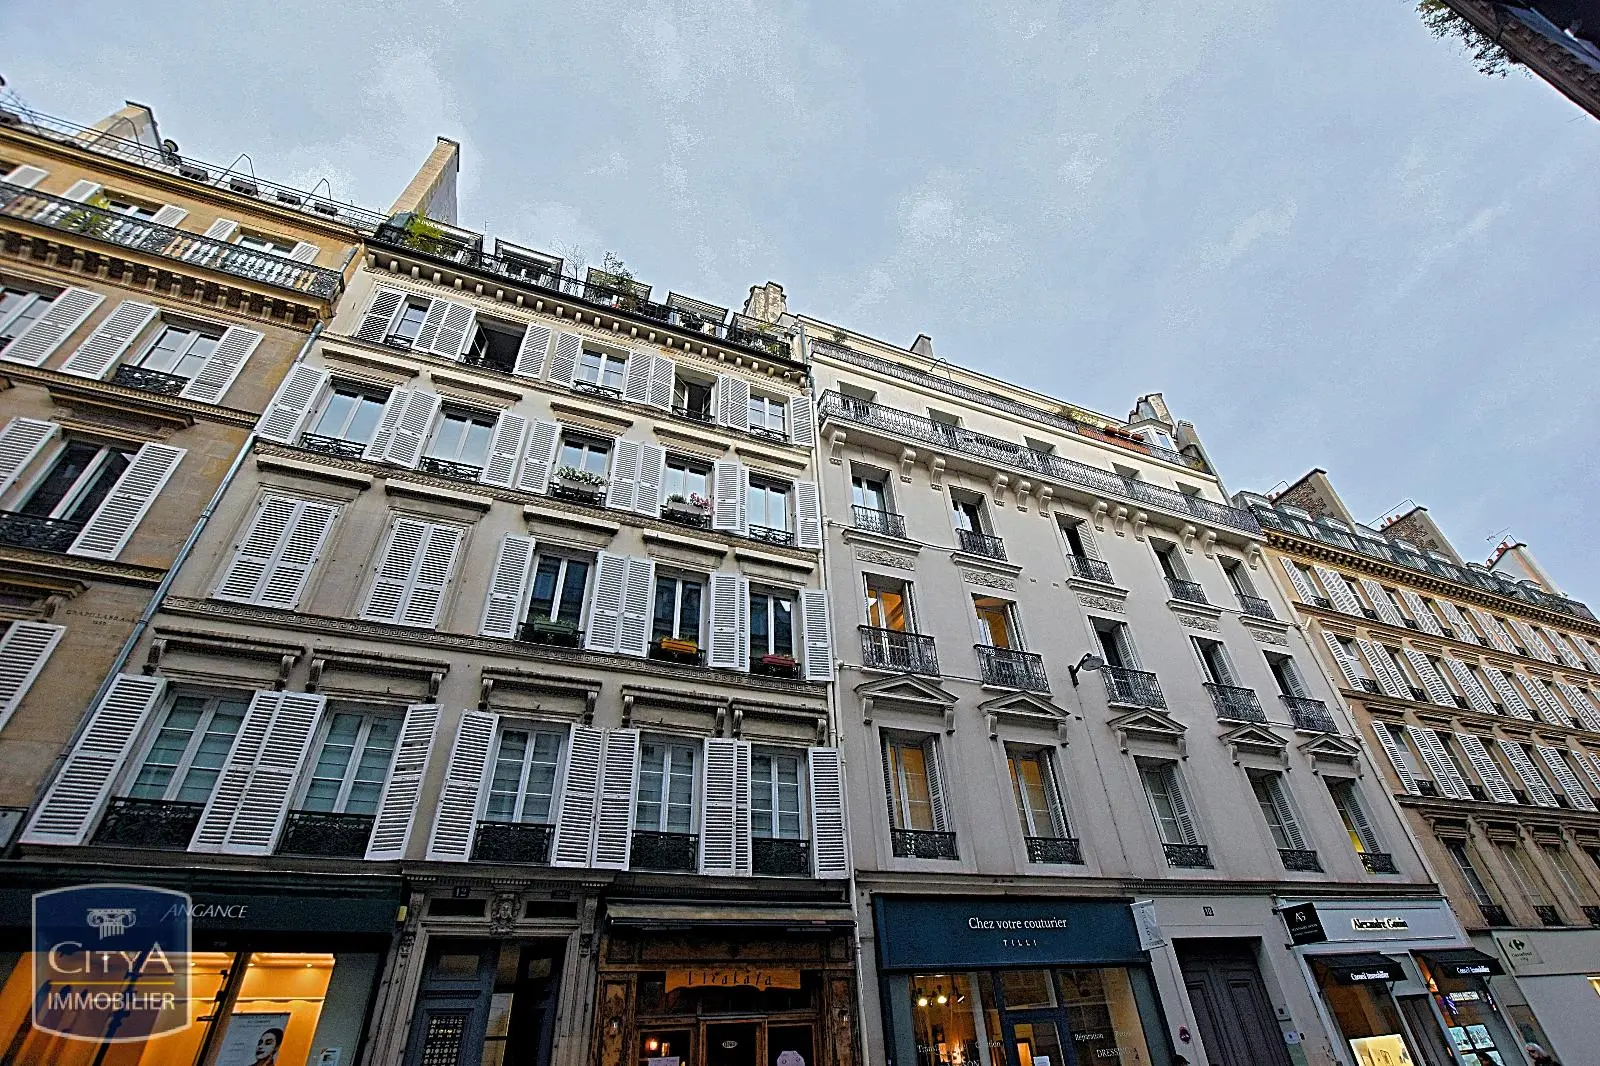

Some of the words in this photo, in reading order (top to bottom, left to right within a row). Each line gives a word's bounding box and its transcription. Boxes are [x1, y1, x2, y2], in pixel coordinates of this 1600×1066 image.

[456, 886, 468, 897] 12
[968, 917, 995, 929] Chez
[996, 919, 1022, 929] votre
[1024, 916, 1067, 929] couturier
[1003, 939, 1037, 947] TILLI
